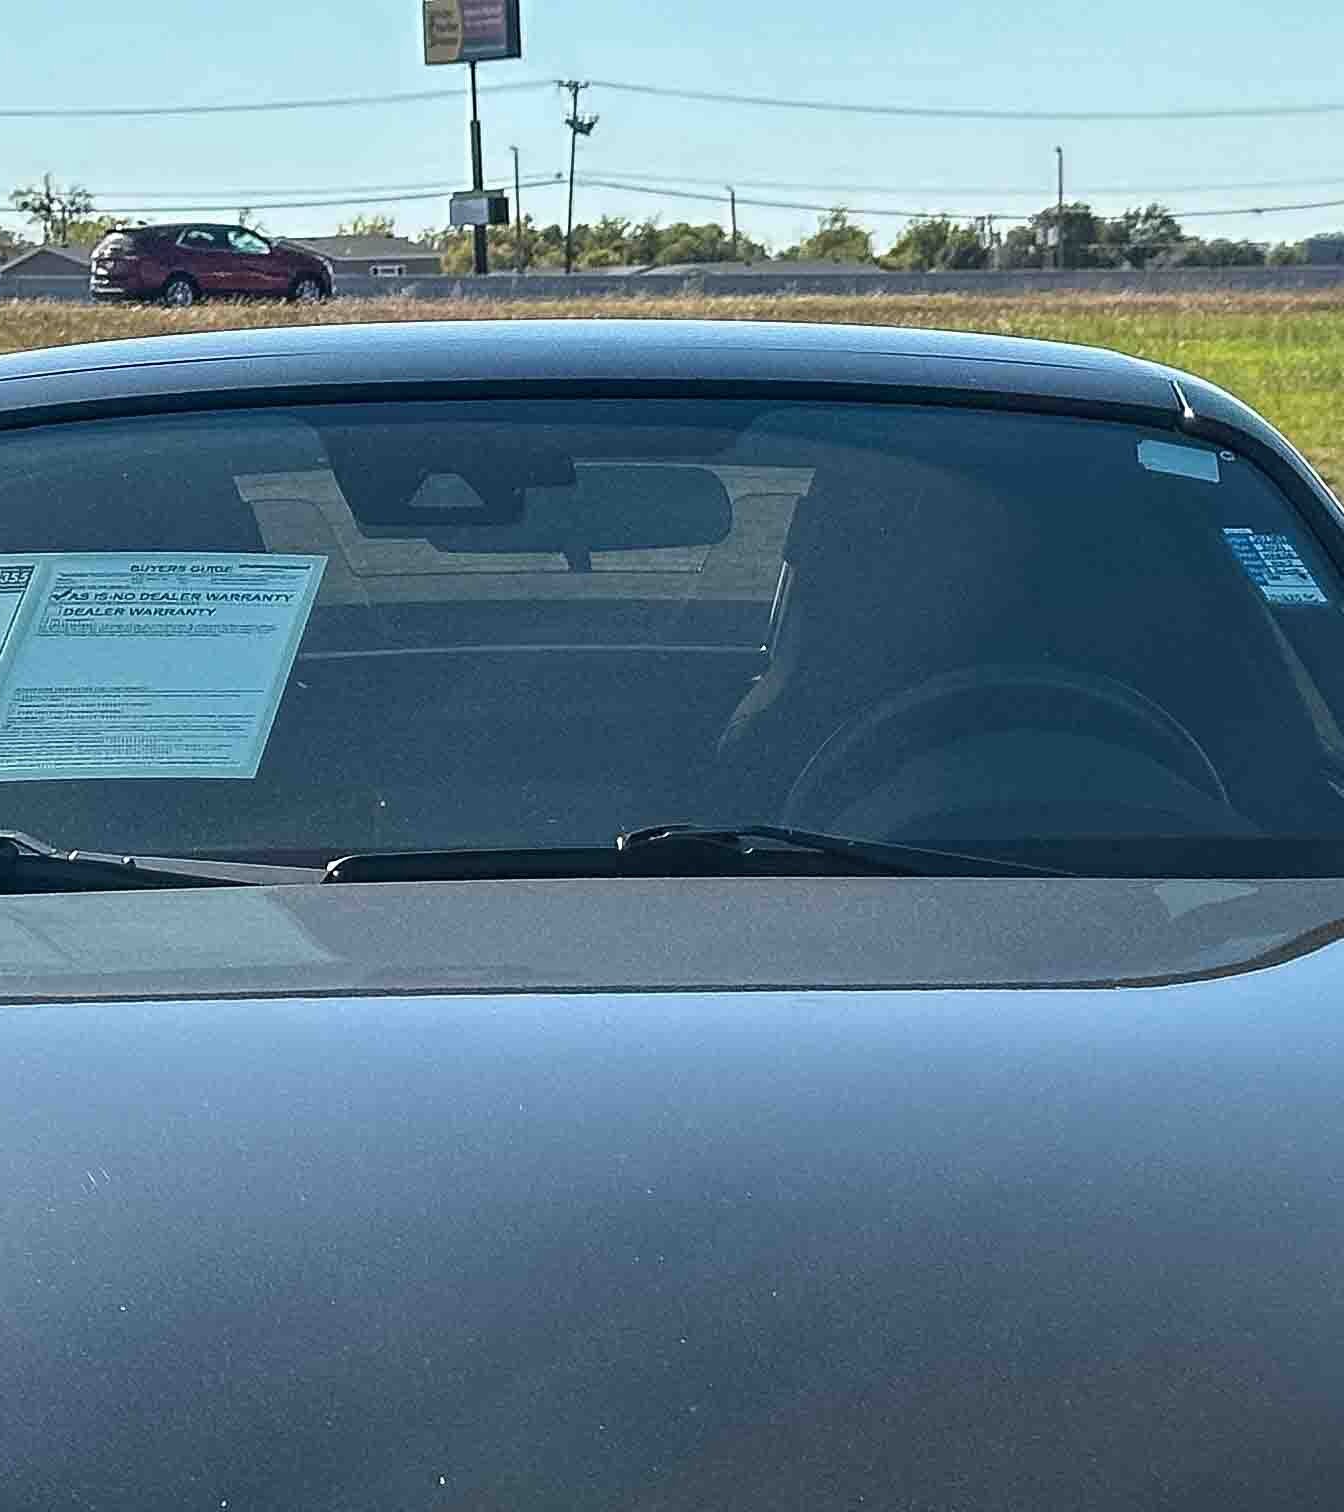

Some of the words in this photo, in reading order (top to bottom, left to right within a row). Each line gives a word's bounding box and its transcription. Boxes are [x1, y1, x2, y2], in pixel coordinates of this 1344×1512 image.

[139, 591, 202, 602] DEALER
[206, 591, 294, 603] WARRANTY
[63, 606, 125, 617] DEALER
[129, 607, 216, 617] WARRANTY
